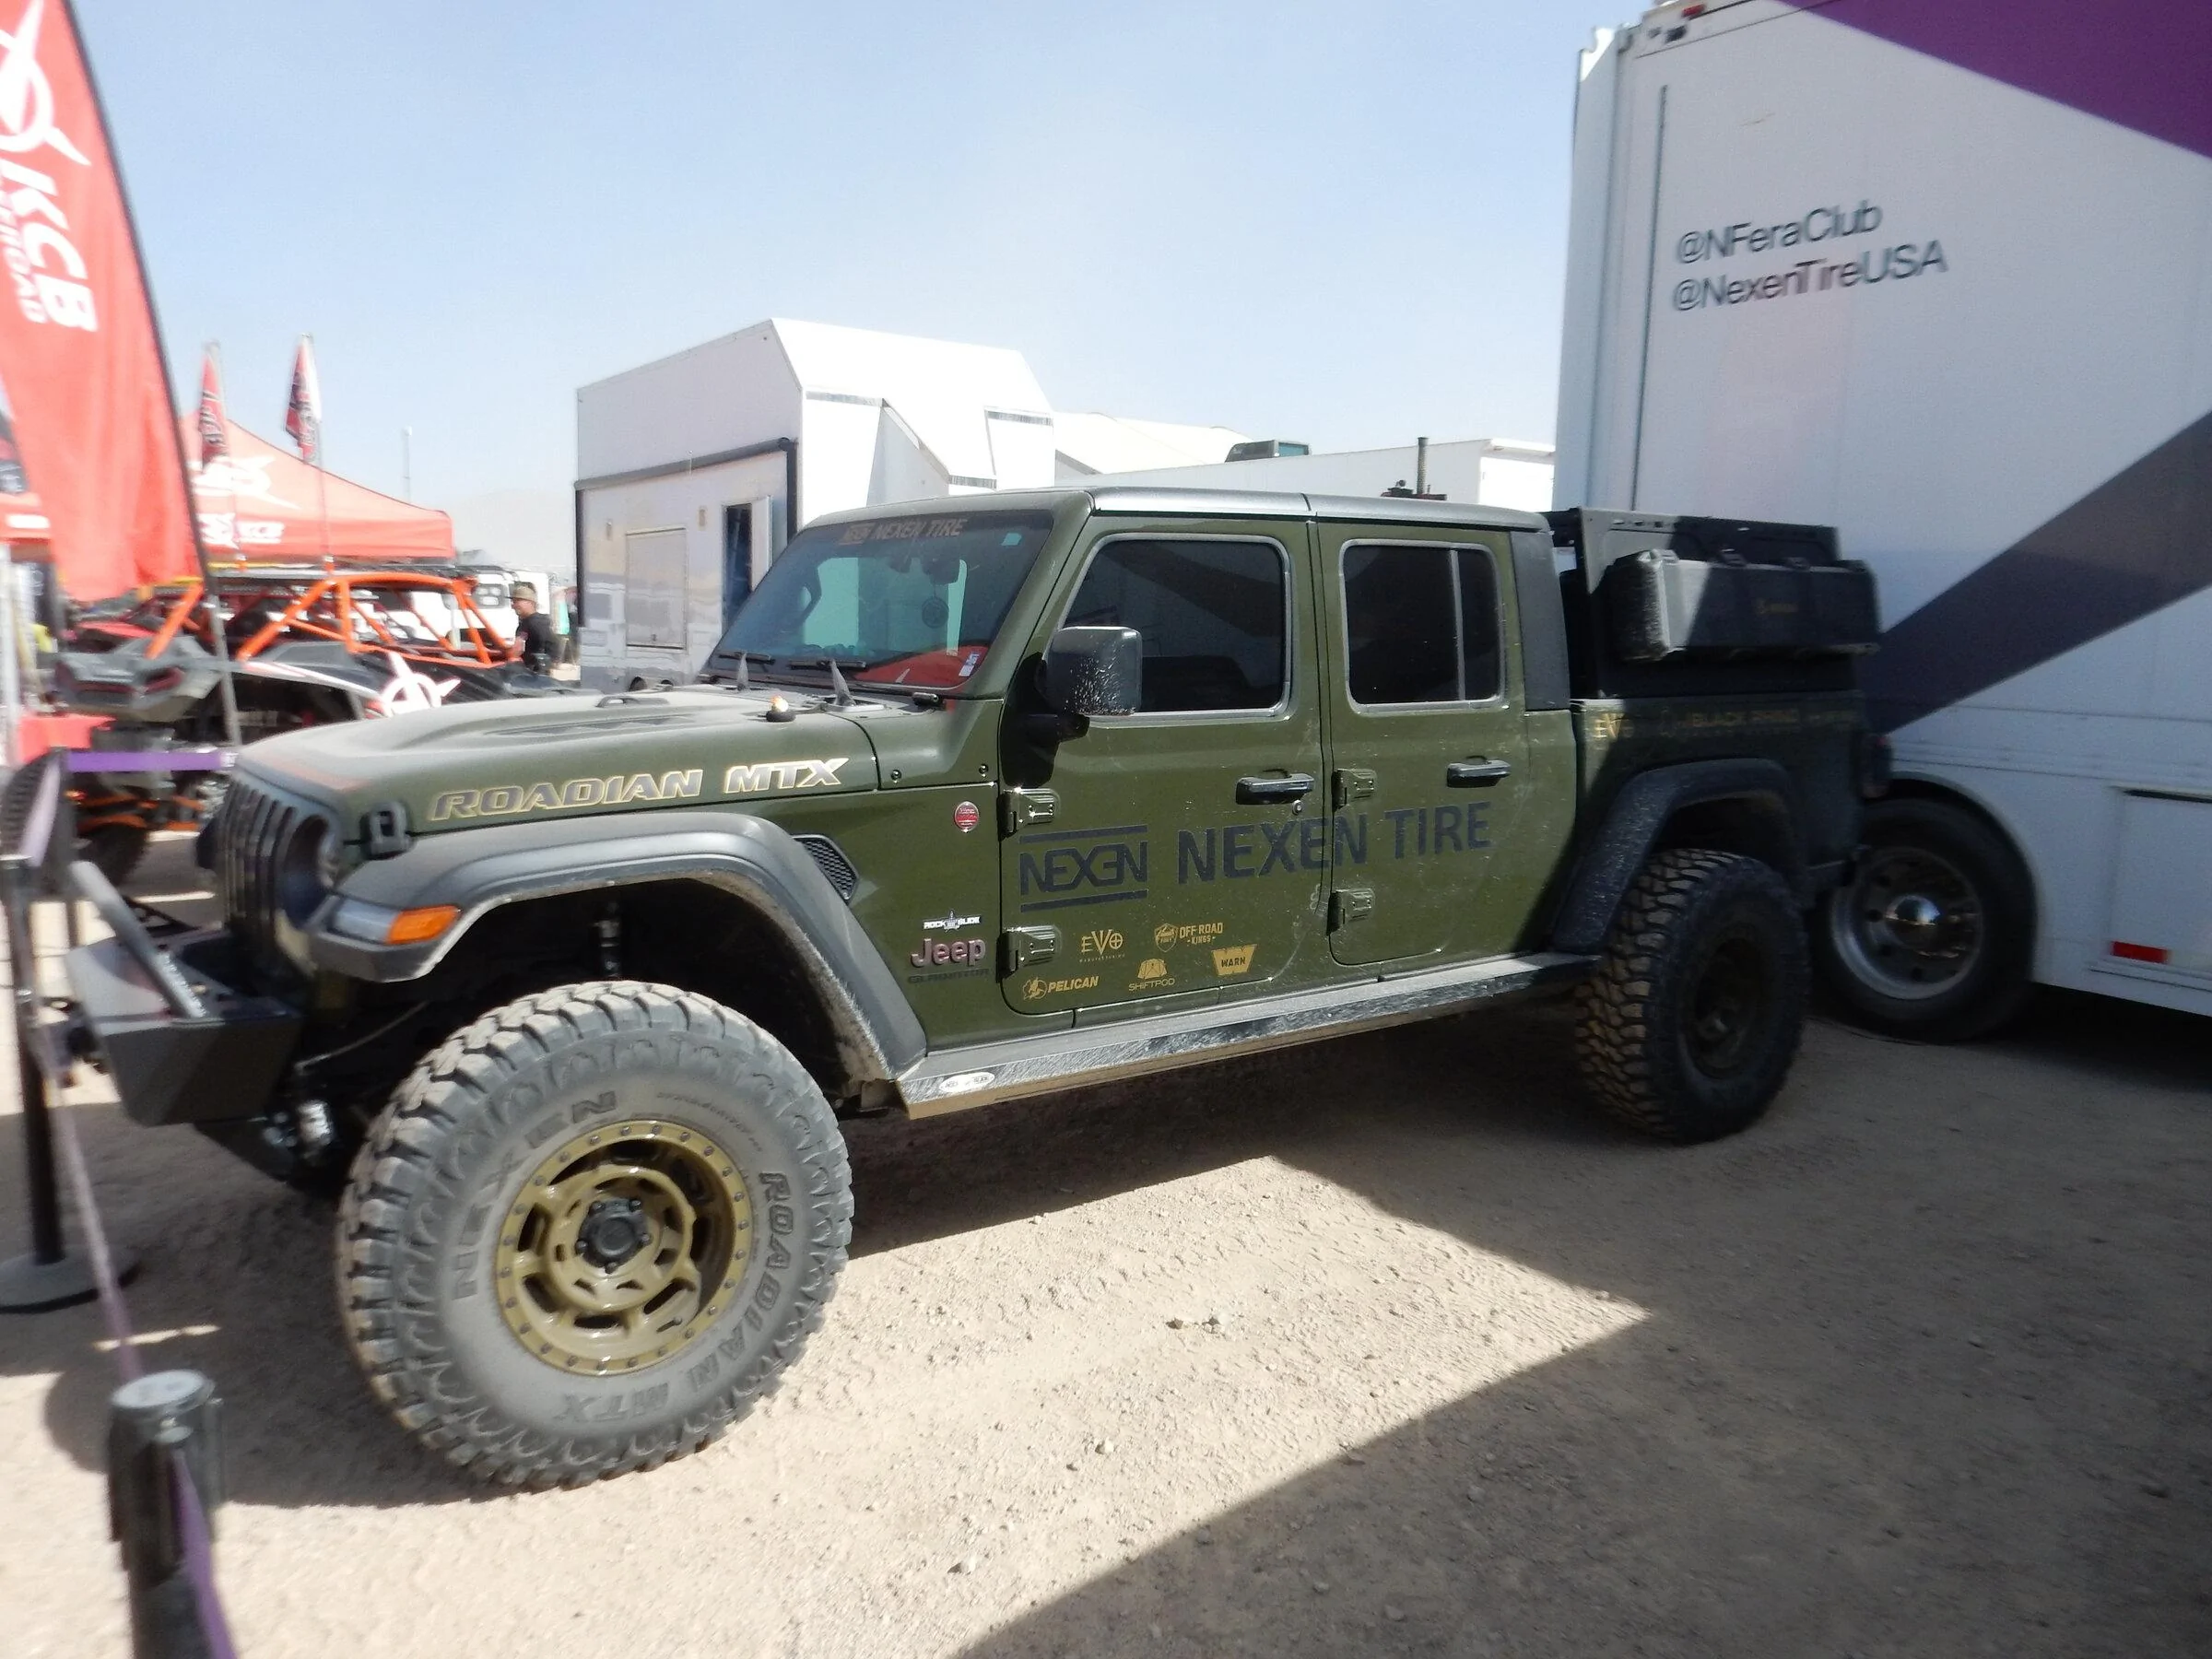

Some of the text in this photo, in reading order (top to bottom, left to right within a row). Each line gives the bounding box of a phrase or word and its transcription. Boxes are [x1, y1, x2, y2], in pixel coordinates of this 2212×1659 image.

[1676, 199, 1884, 264] @NFeraClub
[1673, 239, 1949, 312] @NexenTireUSA
[873, 521, 926, 540] NEXEN
[926, 518, 968, 538] TIRE
[428, 758, 850, 821] ROADIAN MTX
[1178, 801, 1492, 885] NEXEN TIRE
[1019, 840, 1148, 896] NEXEN
[1081, 929, 1124, 956] EVO
[1179, 924, 1197, 939] OFF
[1198, 922, 1224, 935] ROAD
[910, 938, 986, 968] Jeep
[1220, 955, 1247, 969] WARN
[1047, 975, 1100, 994] PELICAN
[1128, 977, 1176, 992] SHIFTPOD
[687, 1171, 794, 1394] ROADIAN
